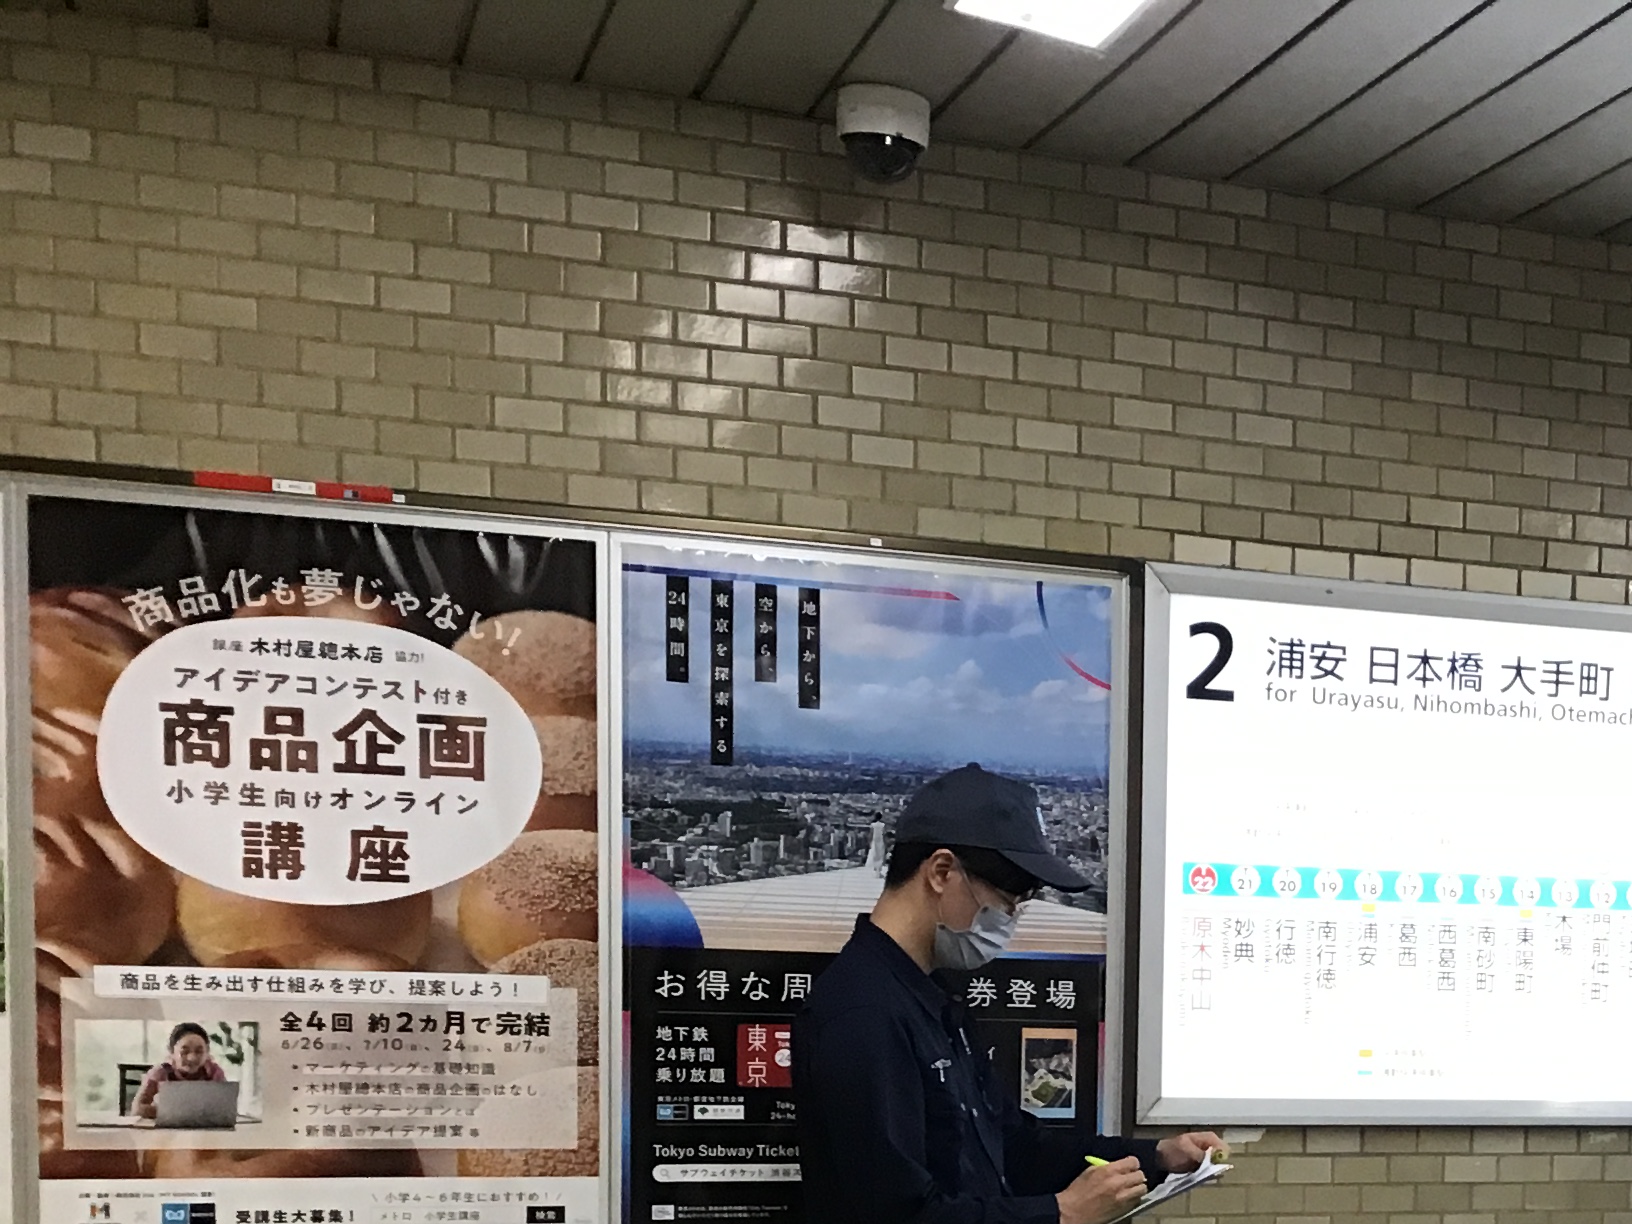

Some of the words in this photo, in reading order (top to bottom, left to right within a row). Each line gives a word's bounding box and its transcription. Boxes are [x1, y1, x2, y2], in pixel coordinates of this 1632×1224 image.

[668, 591, 687, 674] 24時間。
[757, 596, 775, 676] 空から、
[801, 600, 817, 702] 地下から、
[713, 592, 730, 753] 東京を探索する
[1185, 621, 1235, 702] 2
[1266, 637, 1348, 682] 浦安
[1368, 646, 1484, 693] 日本橋
[1500, 656, 1615, 702] 大手町
[173, 667, 469, 706] アイデアコンテスト付き
[1265, 683, 1298, 703] for
[1312, 687, 1405, 713] Urayasu,
[1413, 694, 1543, 721] Nihombashi,
[159, 699, 487, 781] 商品企画
[166, 780, 479, 814] 小学生向けオンライン
[241, 821, 412, 883] 講座
[1238, 878, 1253, 890] 21
[1279, 880, 1296, 892] 20
[1321, 882, 1337, 894] 19
[1362, 883, 1377, 895] 18
[1402, 885, 1417, 897] 17
[1441, 887, 1457, 898] 16
[1481, 888, 1496, 900] 15
[1520, 890, 1534, 901] 14
[1558, 891, 1572, 902] 13
[1596, 893, 1610, 904] 12
[1234, 918, 1255, 963] 妙典
[1276, 919, 1296, 965] 行徳
[1316, 921, 1338, 990] 南行徳
[1358, 923, 1378, 966] 浦安
[1398, 924, 1418, 968] 葛西
[1437, 925, 1456, 992] 西葛西
[1476, 926, 1495, 993] 南砂町
[1191, 917, 1213, 1012] 原木中山
[1515, 928, 1534, 994] 東陽町
[654, 969, 811, 1002] お得な周
[967, 977, 1076, 1009] 券登場
[279, 1011, 353, 1032] 全4回
[368, 1011, 551, 1037] 約2カ月で完結
[656, 1026, 709, 1042] 地下鉄
[656, 1047, 715, 1062] 24時間
[747, 1024, 767, 1087] 東京
[656, 1068, 726, 1083] 乗り放題
[653, 1145, 694, 1159] Tokyo
[698, 1145, 754, 1159] Subway
[235, 1208, 356, 1224] 受講生大募集!
